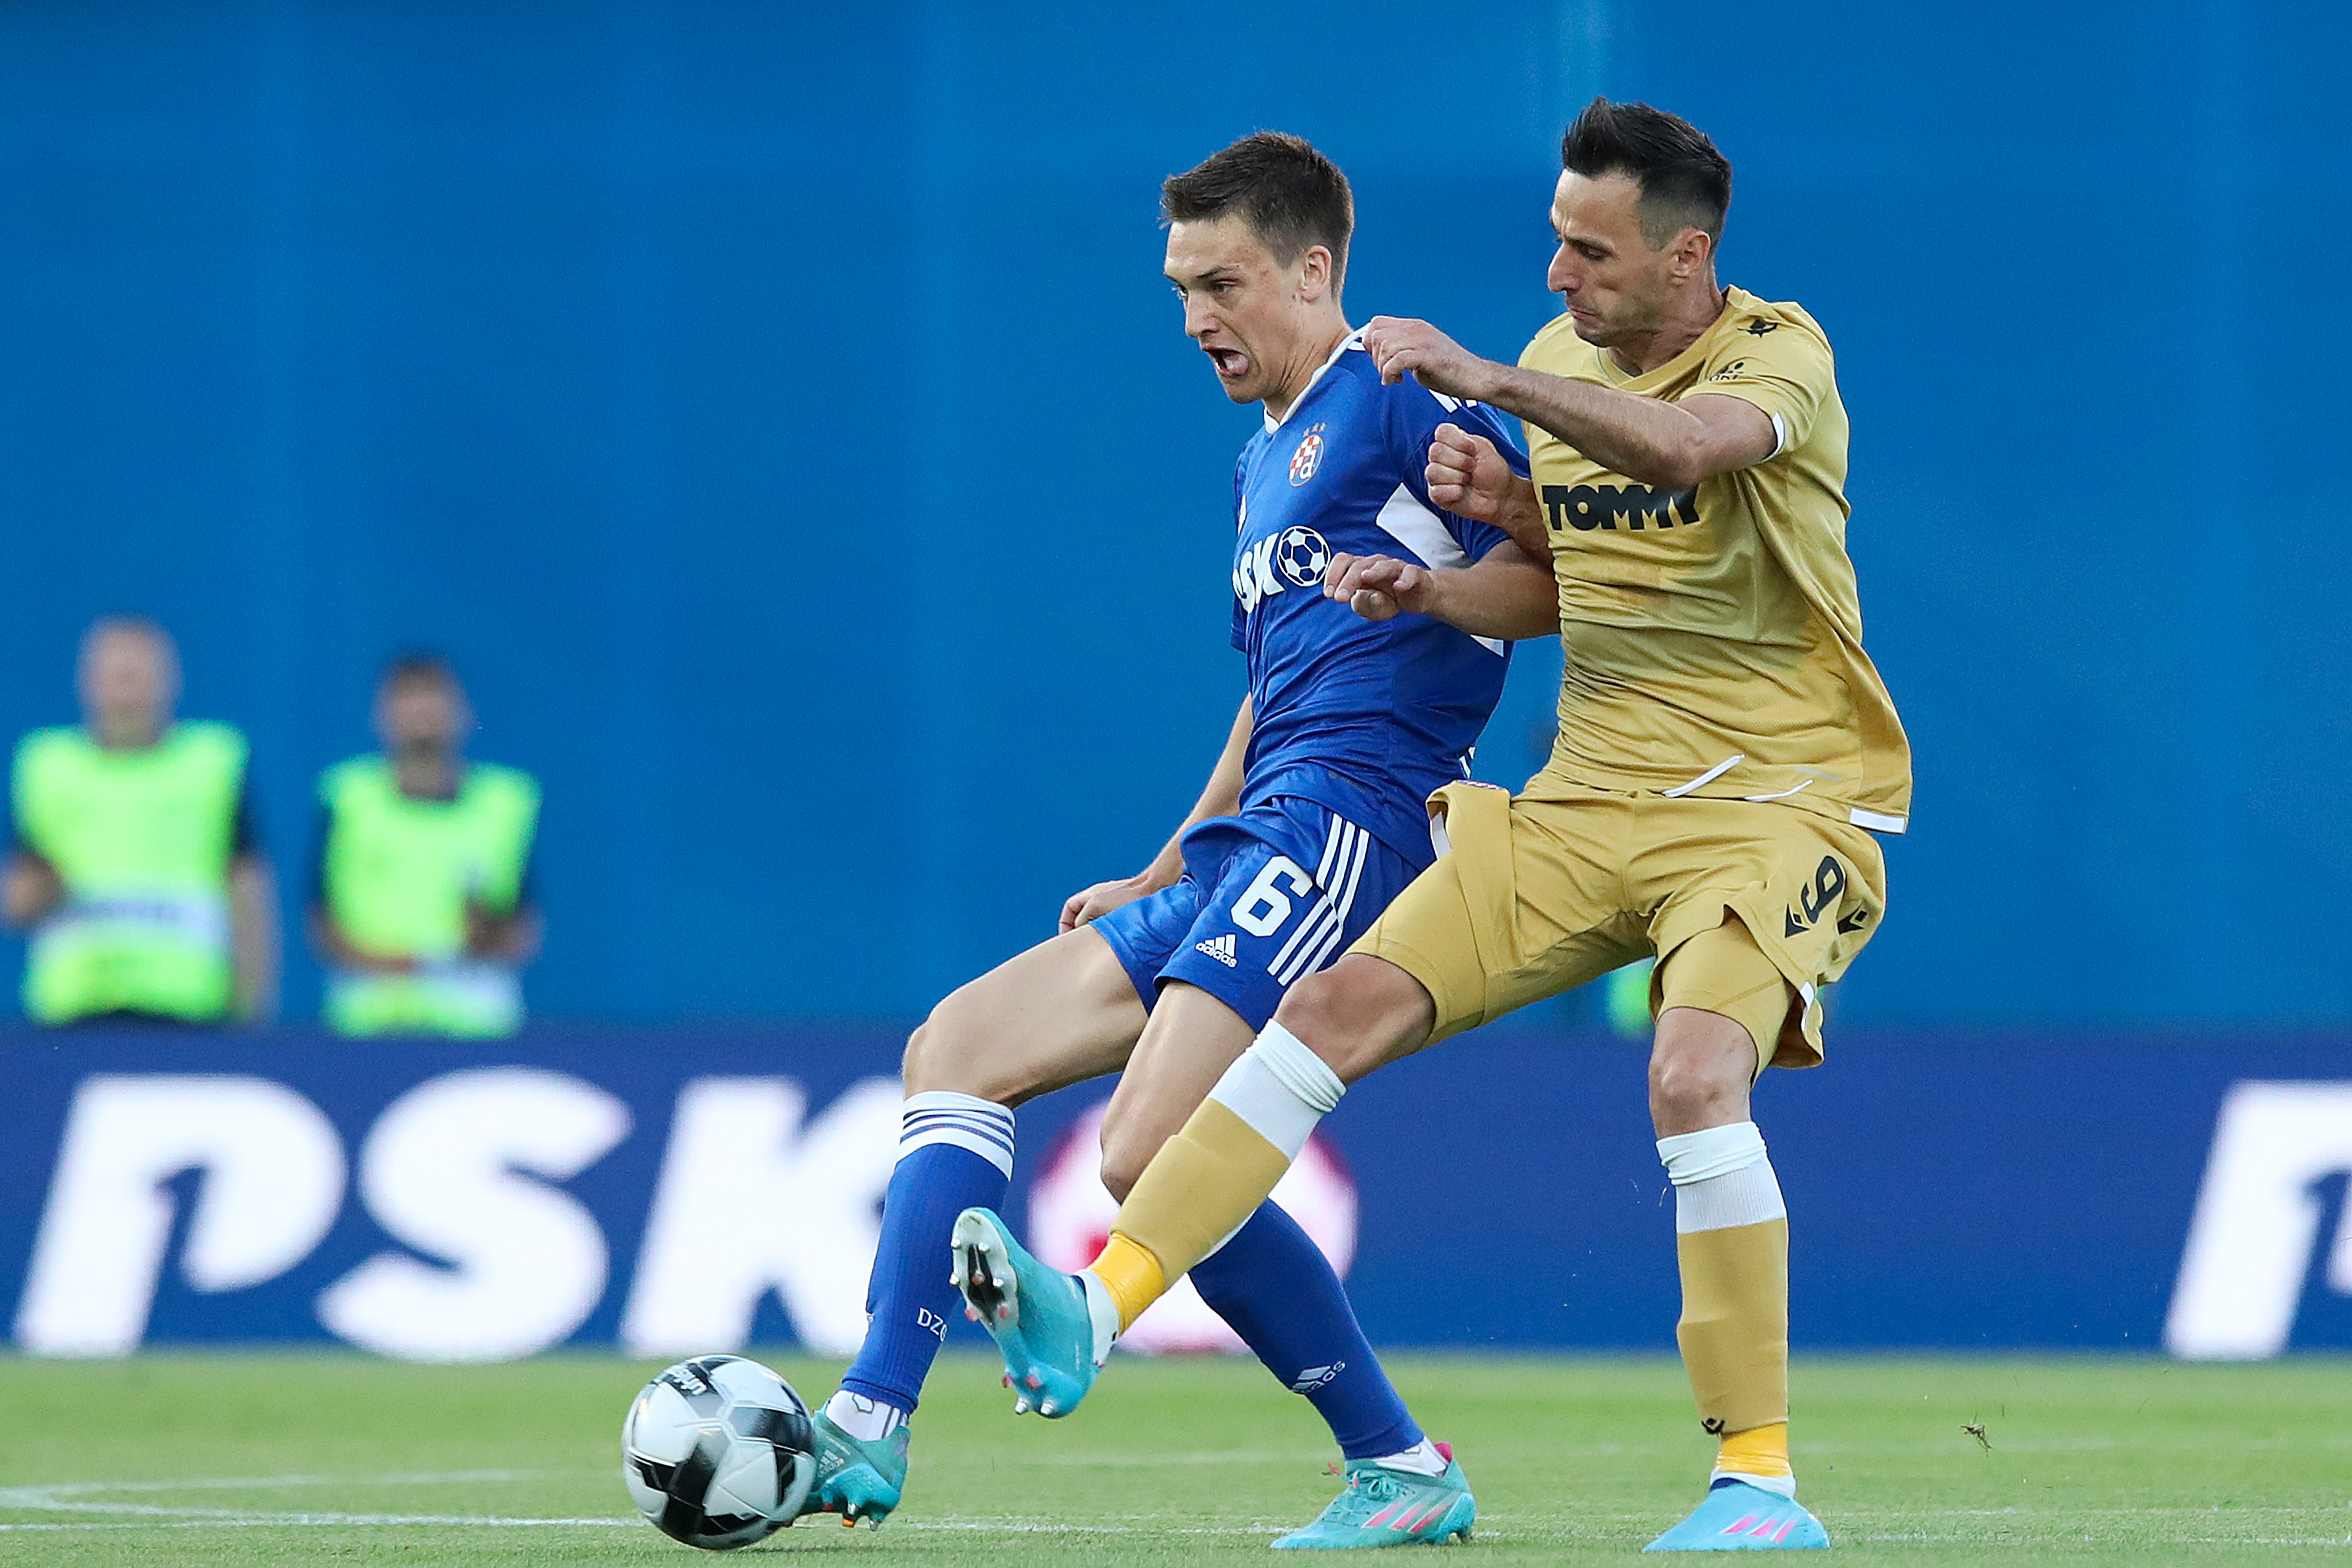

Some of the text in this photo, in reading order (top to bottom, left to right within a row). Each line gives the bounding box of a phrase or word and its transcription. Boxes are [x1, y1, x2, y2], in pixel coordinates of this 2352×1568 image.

[1542, 484, 1699, 531] TOMMY
[1231, 855, 1313, 937] 6
[1800, 855, 1844, 924] 9
[1195, 942, 1237, 968] adidas
[11, 1065, 900, 1364] PSK
